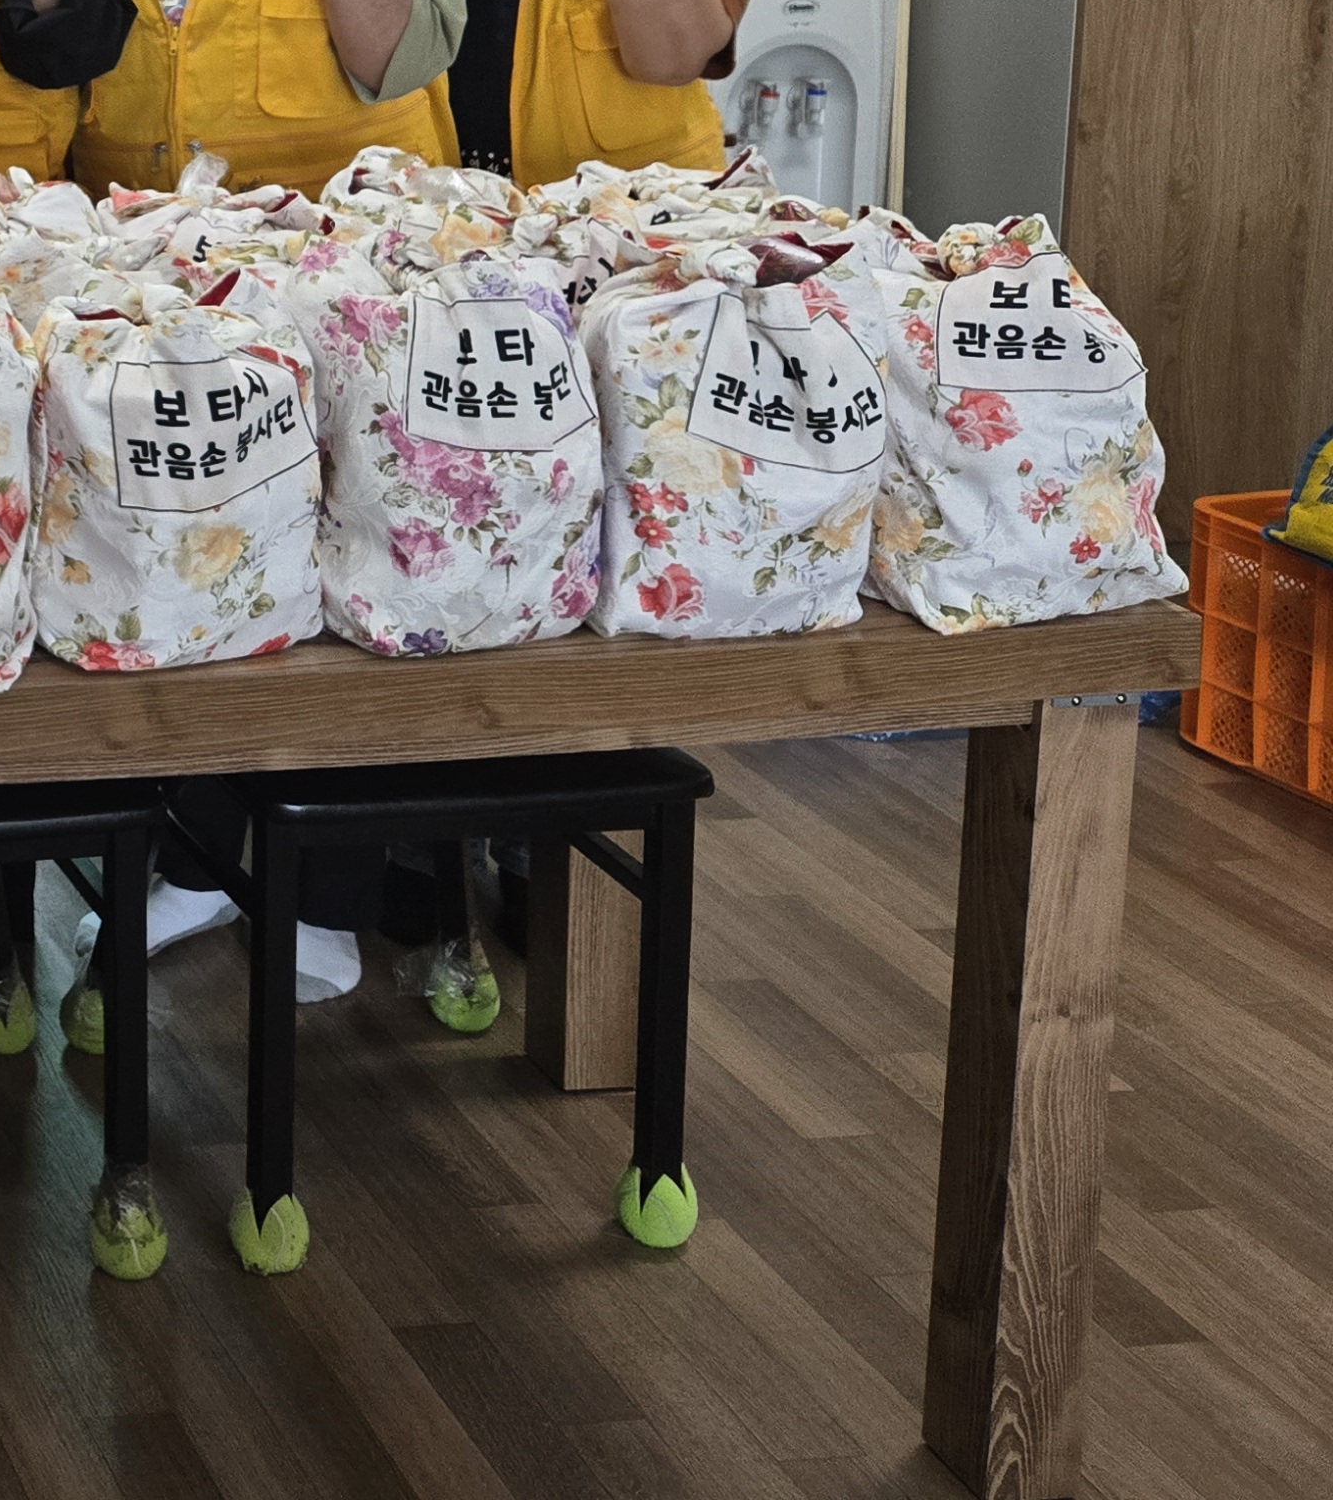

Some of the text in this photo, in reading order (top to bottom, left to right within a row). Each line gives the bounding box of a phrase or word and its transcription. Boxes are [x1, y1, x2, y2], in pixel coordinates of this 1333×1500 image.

[953, 322, 1066, 362] 관음손
[422, 370, 518, 418] 관음손
[127, 394, 296, 480] 관음손 봉사단
